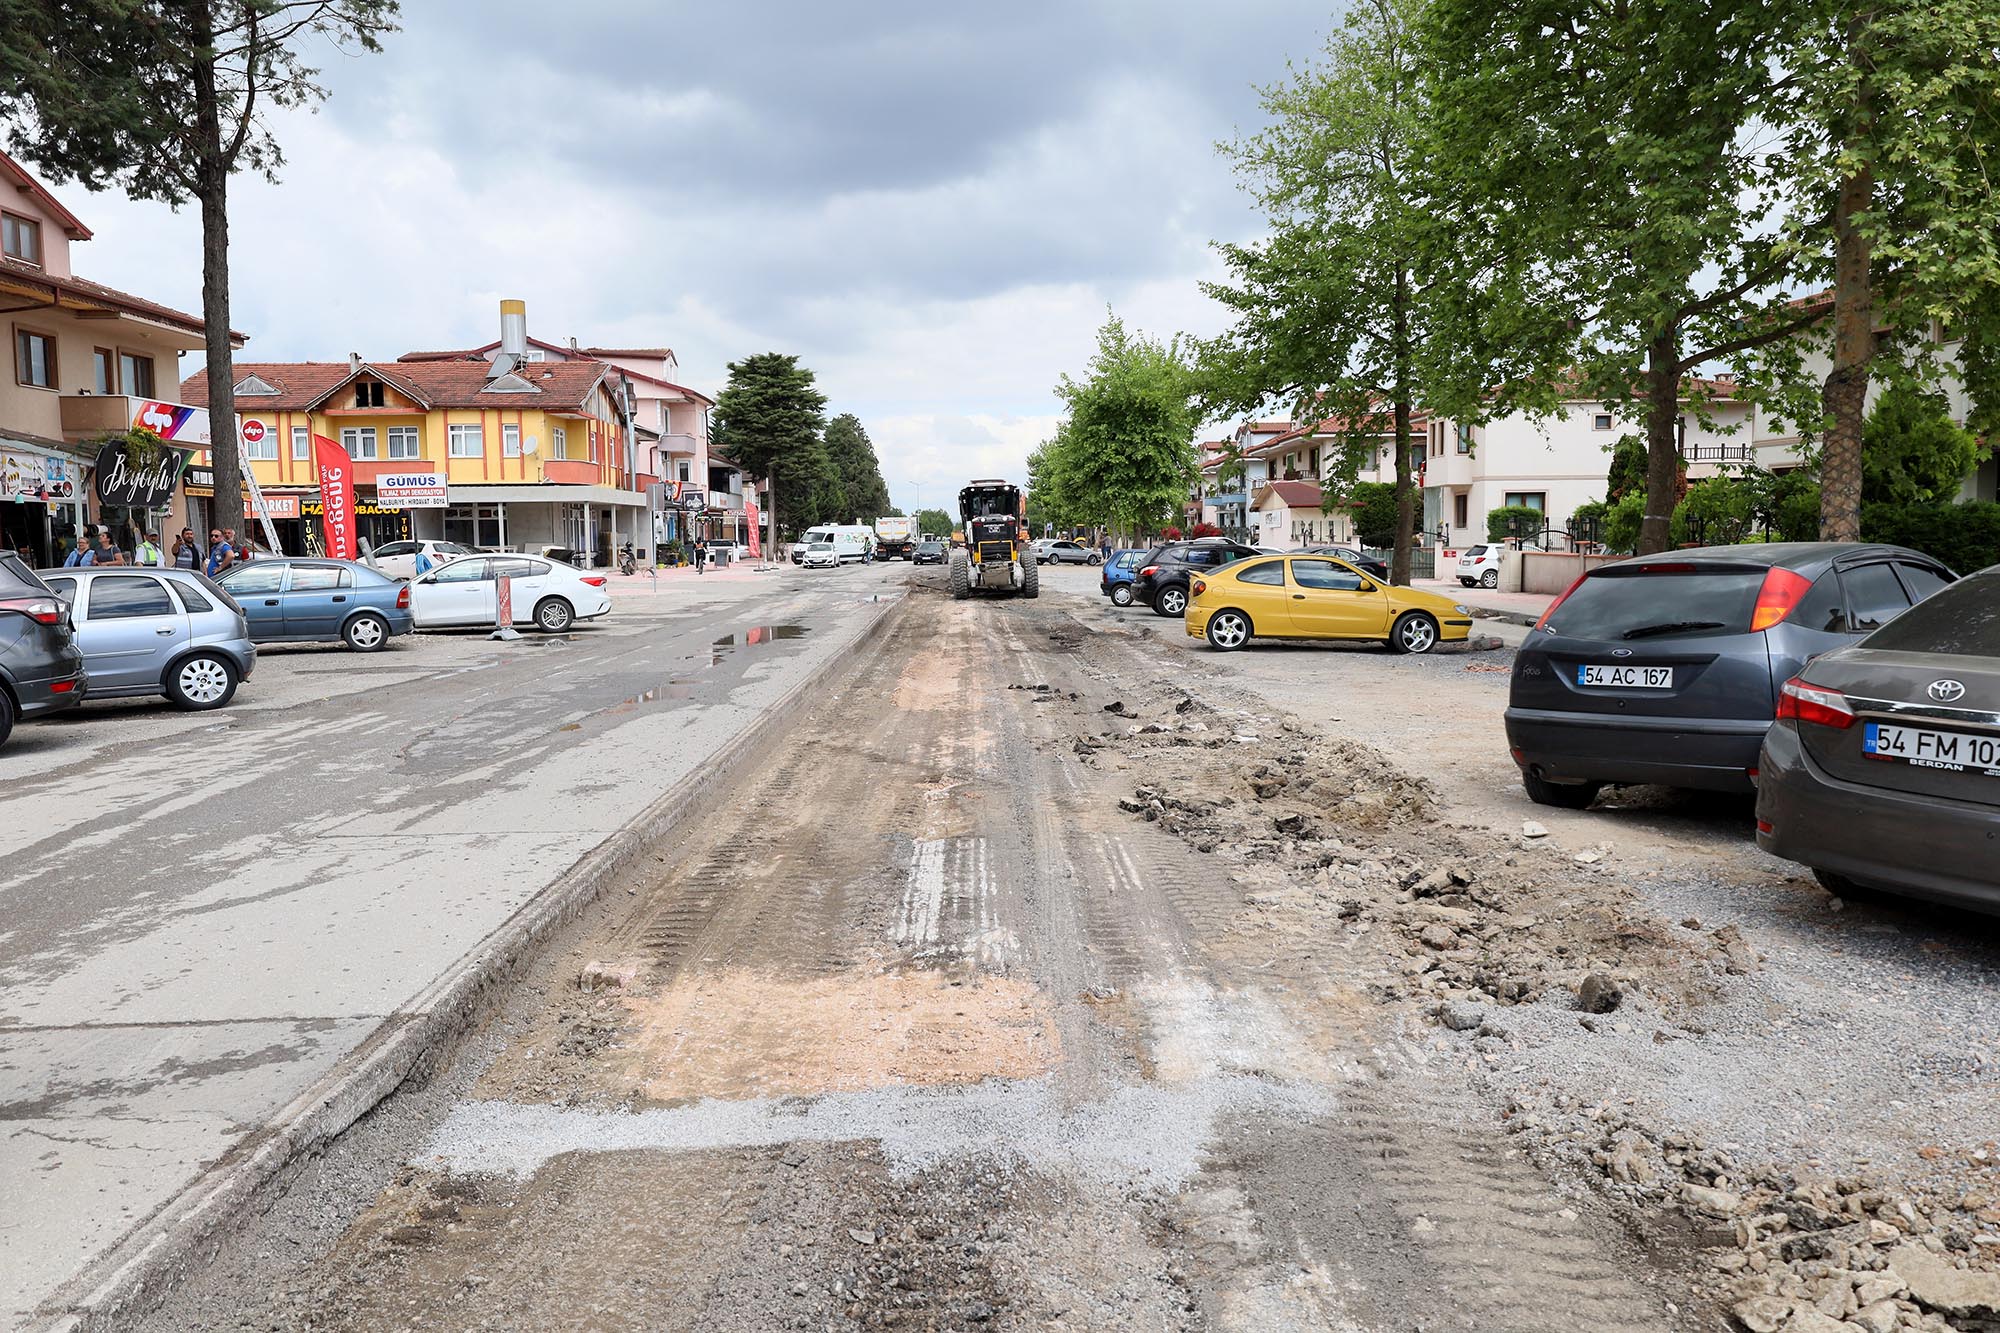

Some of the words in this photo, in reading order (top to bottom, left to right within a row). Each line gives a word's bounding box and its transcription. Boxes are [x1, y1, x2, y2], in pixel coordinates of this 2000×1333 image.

[143, 405, 172, 433] dyo
[244, 426, 262, 436] dyo
[386, 475, 436, 487] GÜMÜŞ
[1586, 667, 1603, 684] 54
[1610, 668, 1636, 685] AC
[1643, 668, 1670, 686] 167
[1878, 727, 1905, 753] 54
[1917, 732, 1958, 761] FM
[1909, 758, 1964, 772] BERDAN
